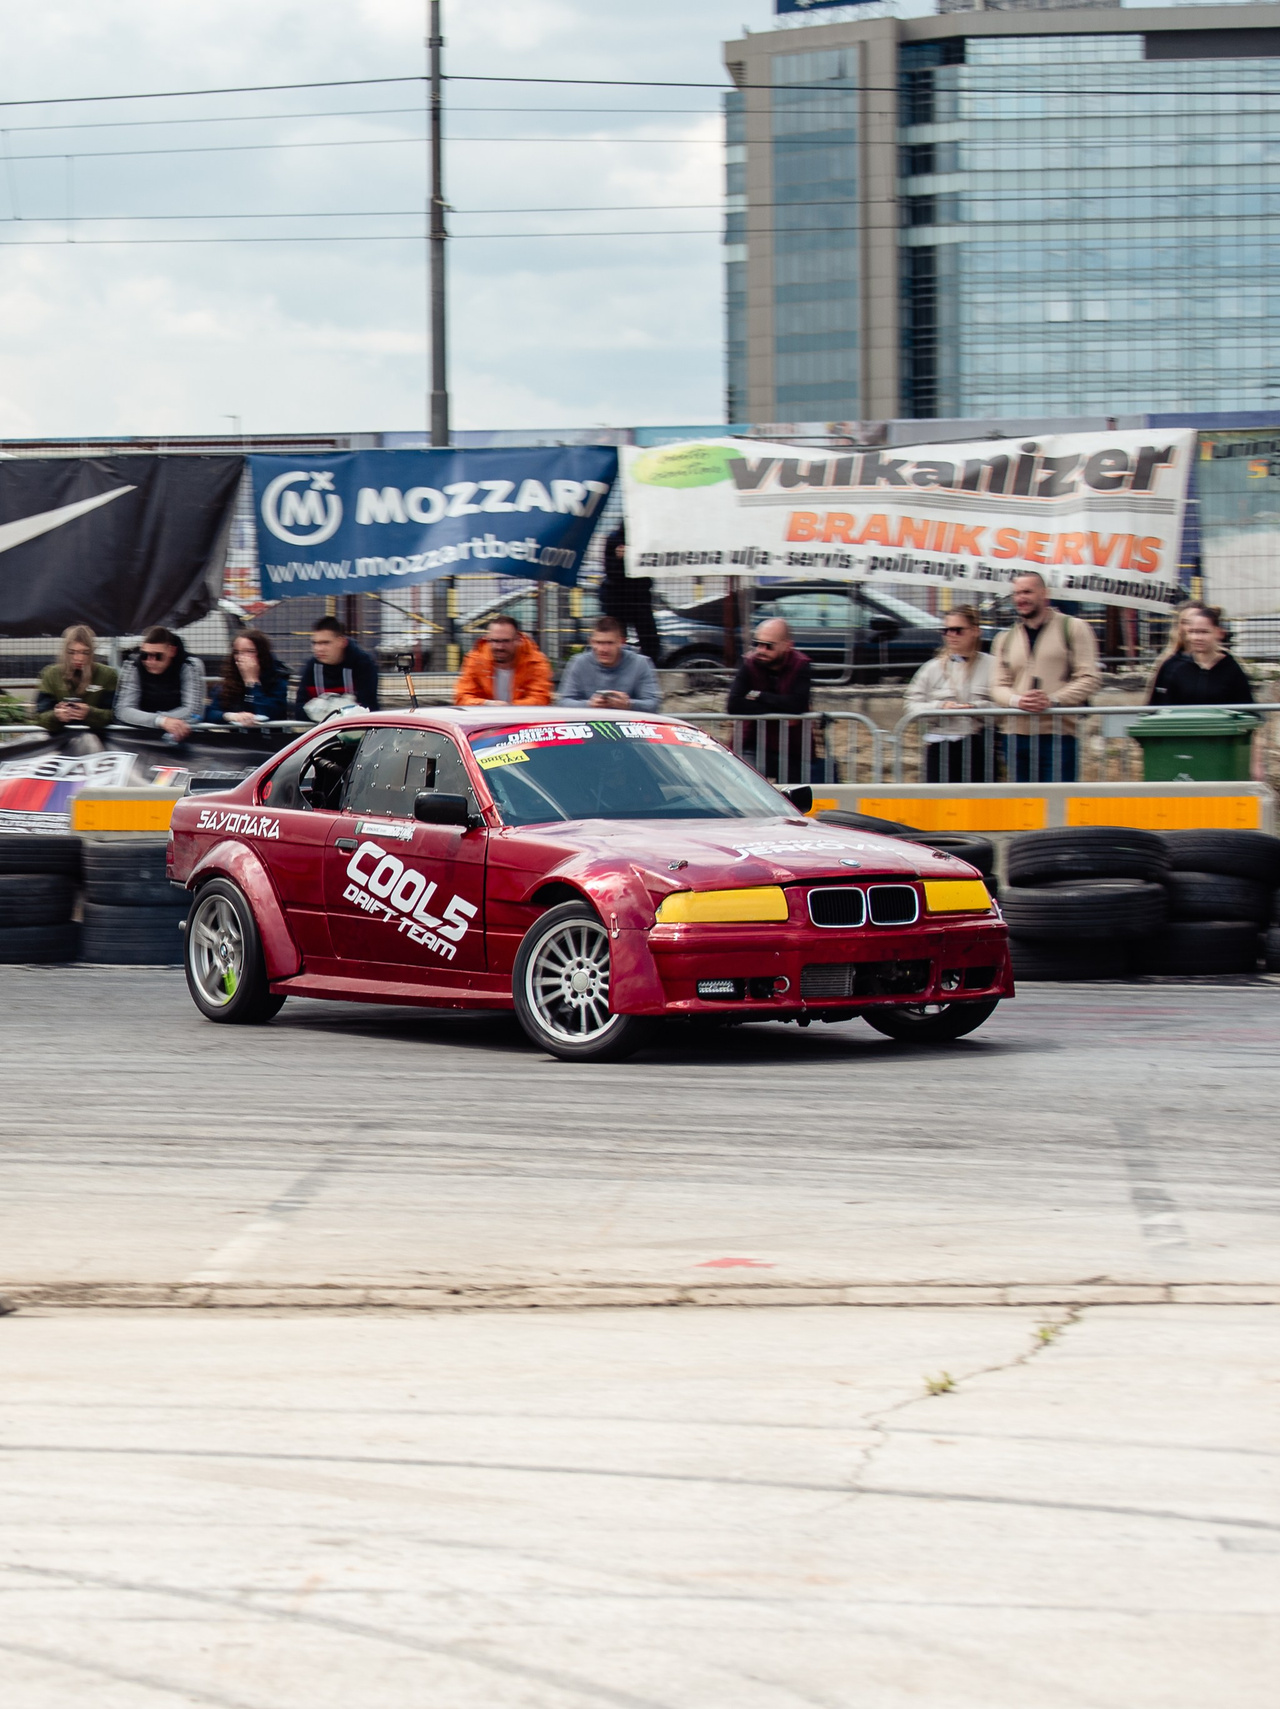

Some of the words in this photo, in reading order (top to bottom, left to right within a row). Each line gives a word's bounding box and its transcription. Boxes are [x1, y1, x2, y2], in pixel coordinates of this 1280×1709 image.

[728, 441, 1176, 498] vulkanizer
[355, 479, 609, 526] MOZZART
[785, 511, 984, 556] BRANIK
[991, 527, 1164, 574] SERVIS
[480, 753, 511, 764] DRIFT
[502, 755, 524, 764] TAXI
[196, 809, 281, 841] SAYONARA
[342, 883, 399, 923] DRIFT
[397, 916, 458, 961] TEAM
